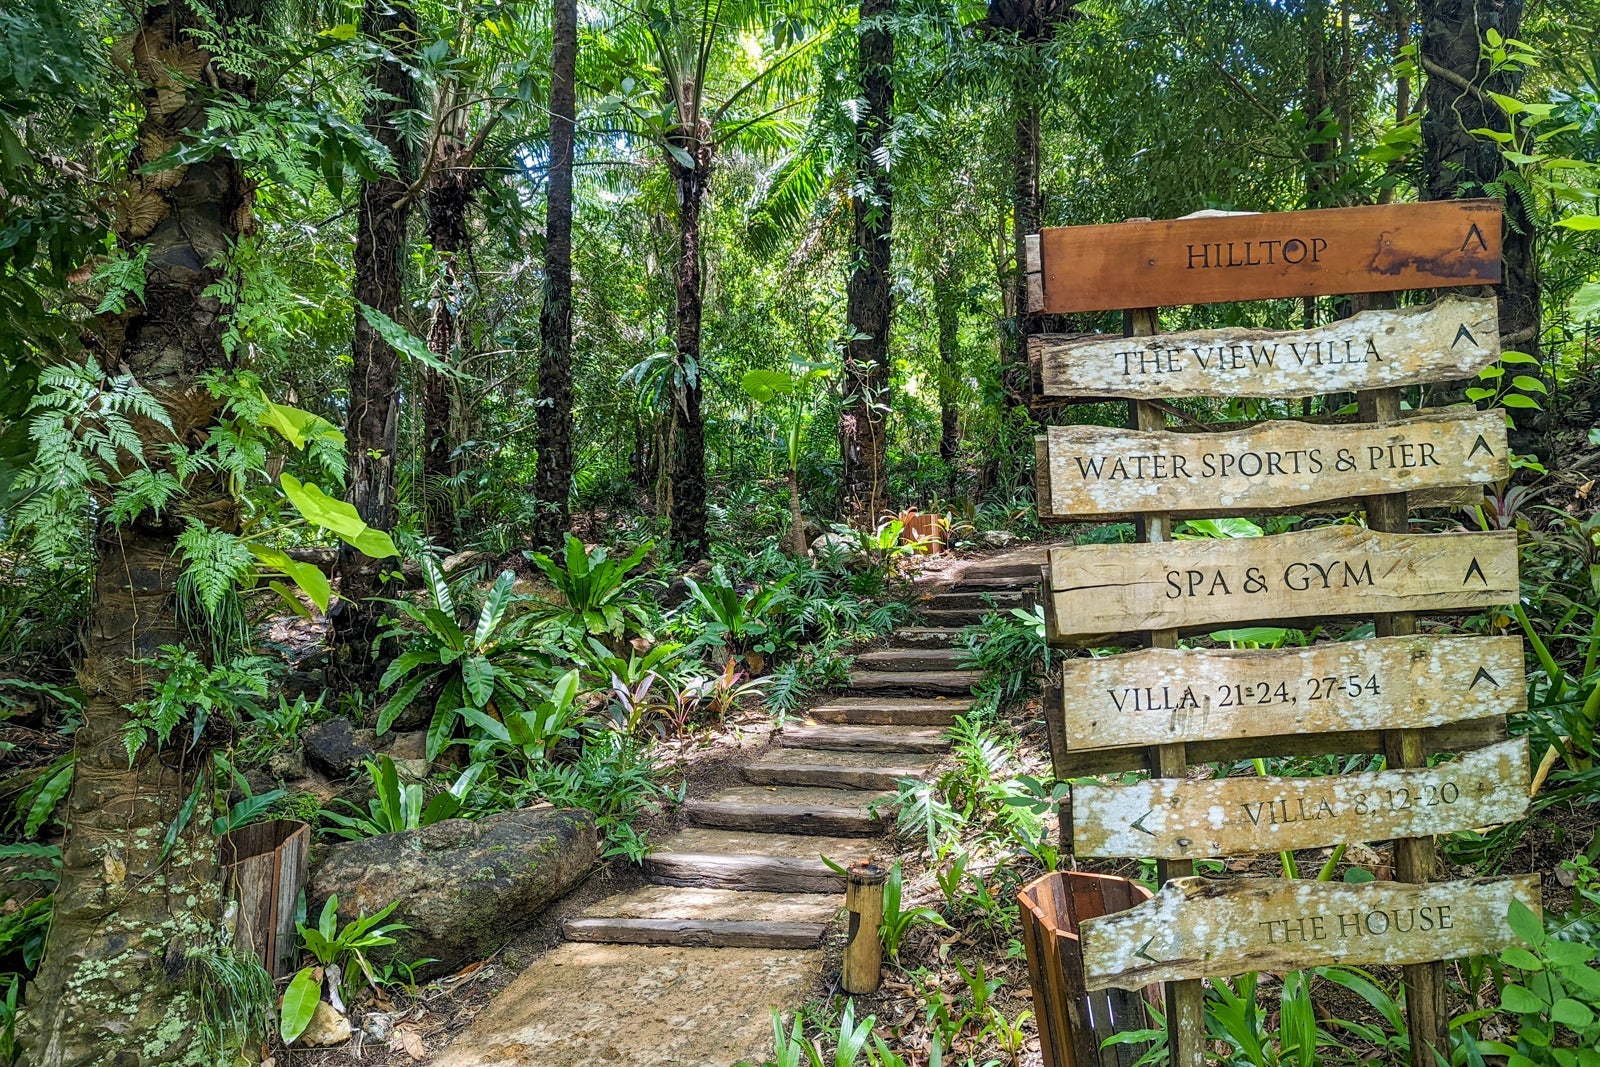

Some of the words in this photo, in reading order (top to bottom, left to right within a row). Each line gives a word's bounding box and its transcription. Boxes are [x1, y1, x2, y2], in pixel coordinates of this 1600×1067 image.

[1186, 237, 1329, 270] HILLTOP
[1114, 348, 1182, 376] THE
[1191, 343, 1279, 371] VIEW
[1293, 338, 1383, 367] VILLA
[1074, 455, 1192, 481] WATER
[1201, 448, 1323, 478] SPORTS
[1334, 448, 1357, 473] &
[1367, 442, 1441, 470] PIER
[1165, 568, 1233, 599] SPA
[1243, 567, 1268, 594] &
[1284, 559, 1375, 592] GYM
[1107, 686, 1201, 713] VILLA
[1218, 681, 1297, 708] 21-24,
[1307, 674, 1381, 701] 27-54
[1241, 797, 1336, 826] VILLA
[1354, 793, 1376, 819] 8,
[1385, 782, 1460, 812] 12-20
[1259, 916, 1327, 945] THE
[1338, 905, 1455, 938] HOUSE
